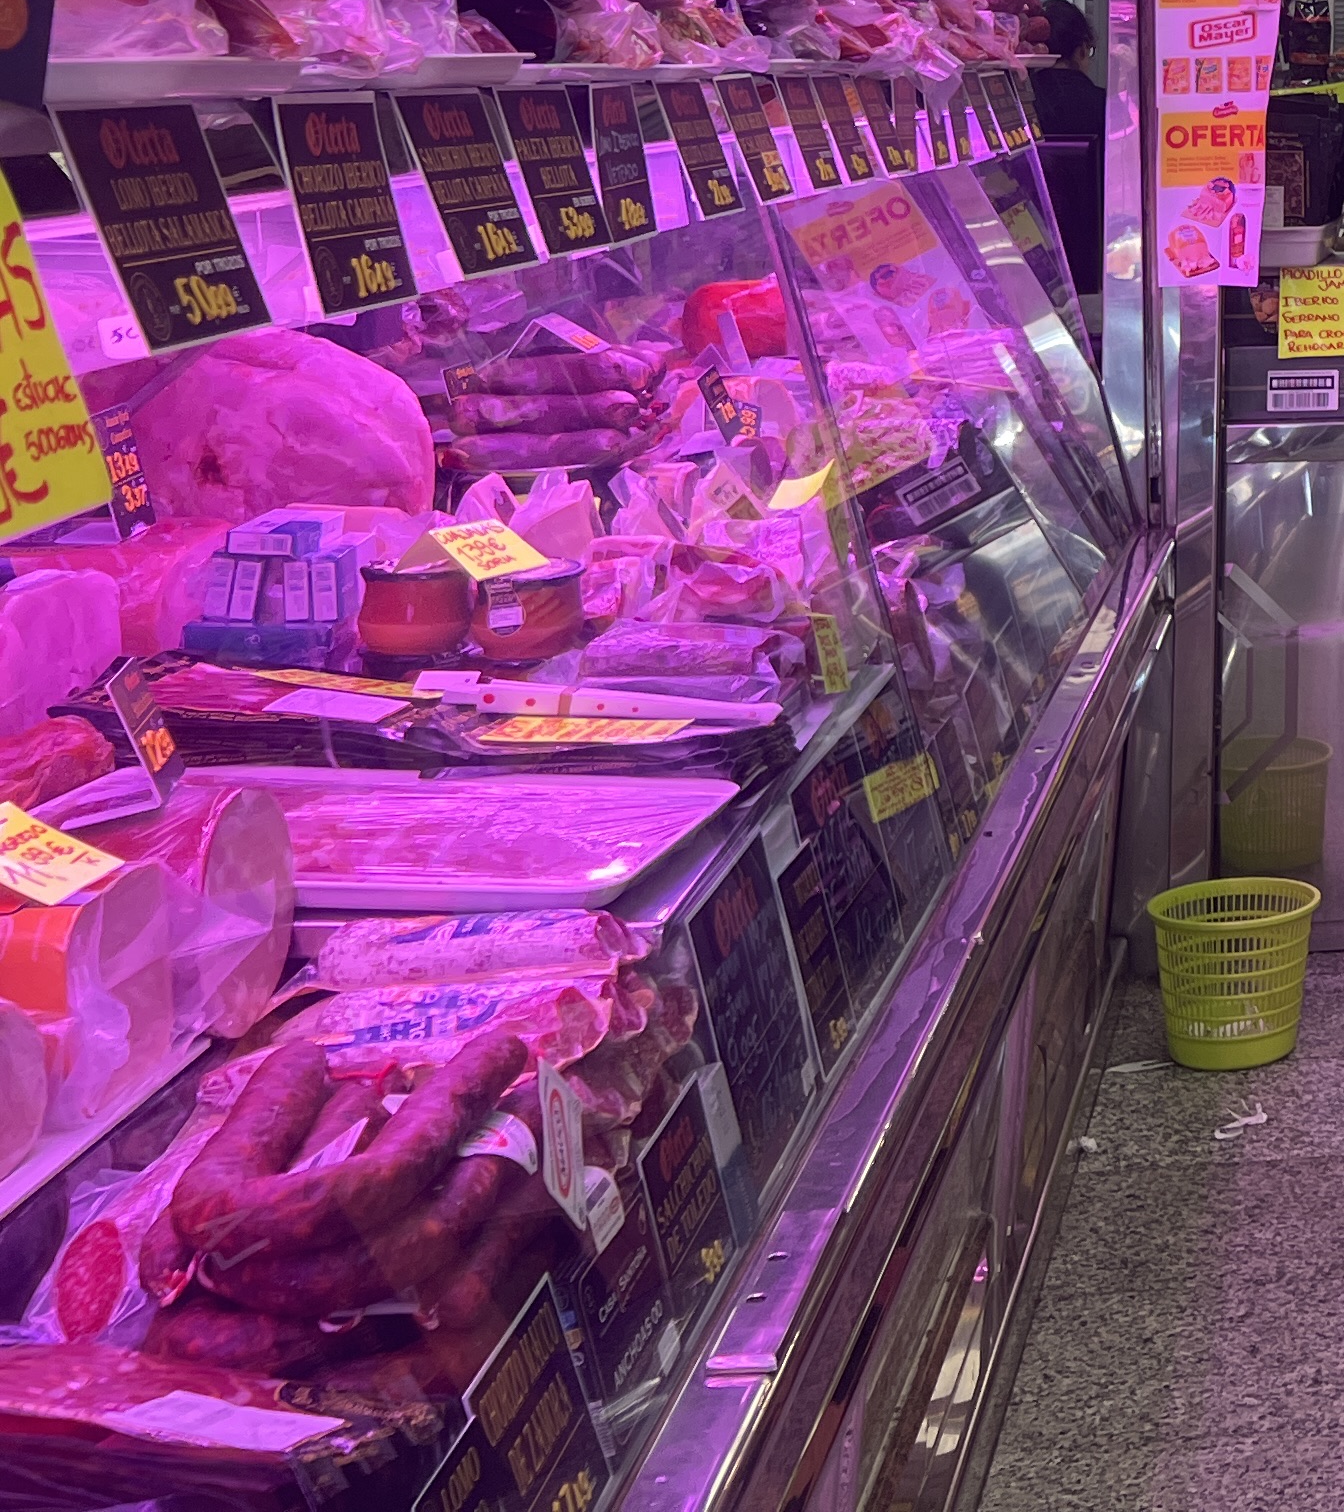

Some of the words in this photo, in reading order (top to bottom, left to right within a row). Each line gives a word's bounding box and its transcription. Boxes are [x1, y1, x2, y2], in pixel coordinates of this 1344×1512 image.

[1198, 28, 1249, 43] Mayer
[1201, 18, 1248, 34] Oscar
[305, 112, 361, 157] Oferta
[294, 163, 344, 194] CHORIZO
[110, 178, 150, 211] LOMO
[300, 200, 349, 231] BELLOTA
[1281, 268, 1343, 280] PICADILLO
[1282, 296, 1339, 307] IBERICO
[1284, 329, 1313, 340] PARA
[667, 1232, 685, 1265] DE
[680, 1169, 717, 1239] TOLEDO
[613, 1315, 652, 1388] ANCHOAS
